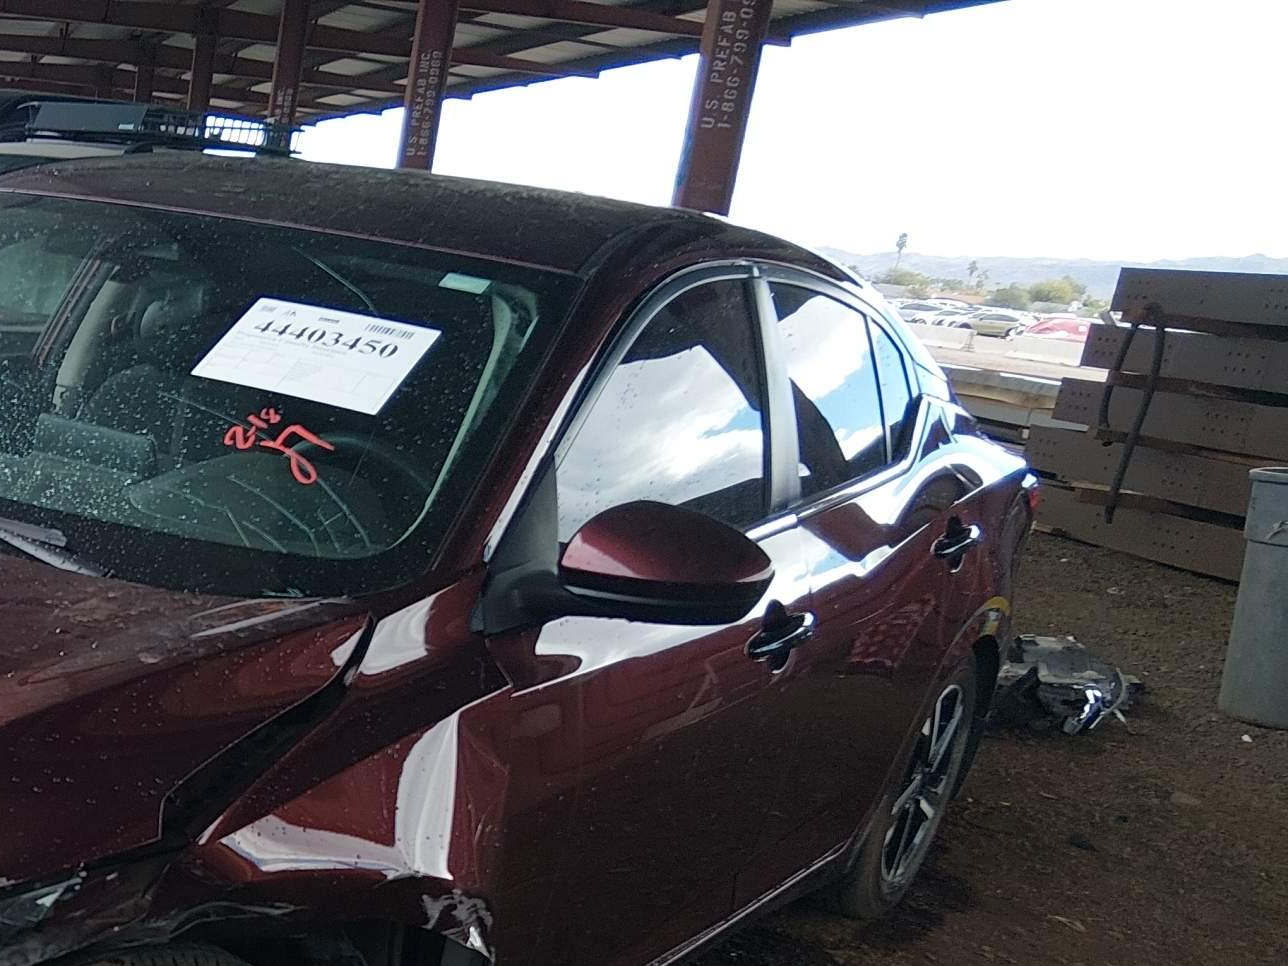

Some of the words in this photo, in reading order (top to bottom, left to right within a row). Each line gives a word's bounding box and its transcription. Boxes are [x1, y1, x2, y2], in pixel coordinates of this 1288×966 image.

[710, 10, 737, 83] PREFAB
[411, 78, 427, 127] PREFAB
[253, 319, 398, 359] 44403450
